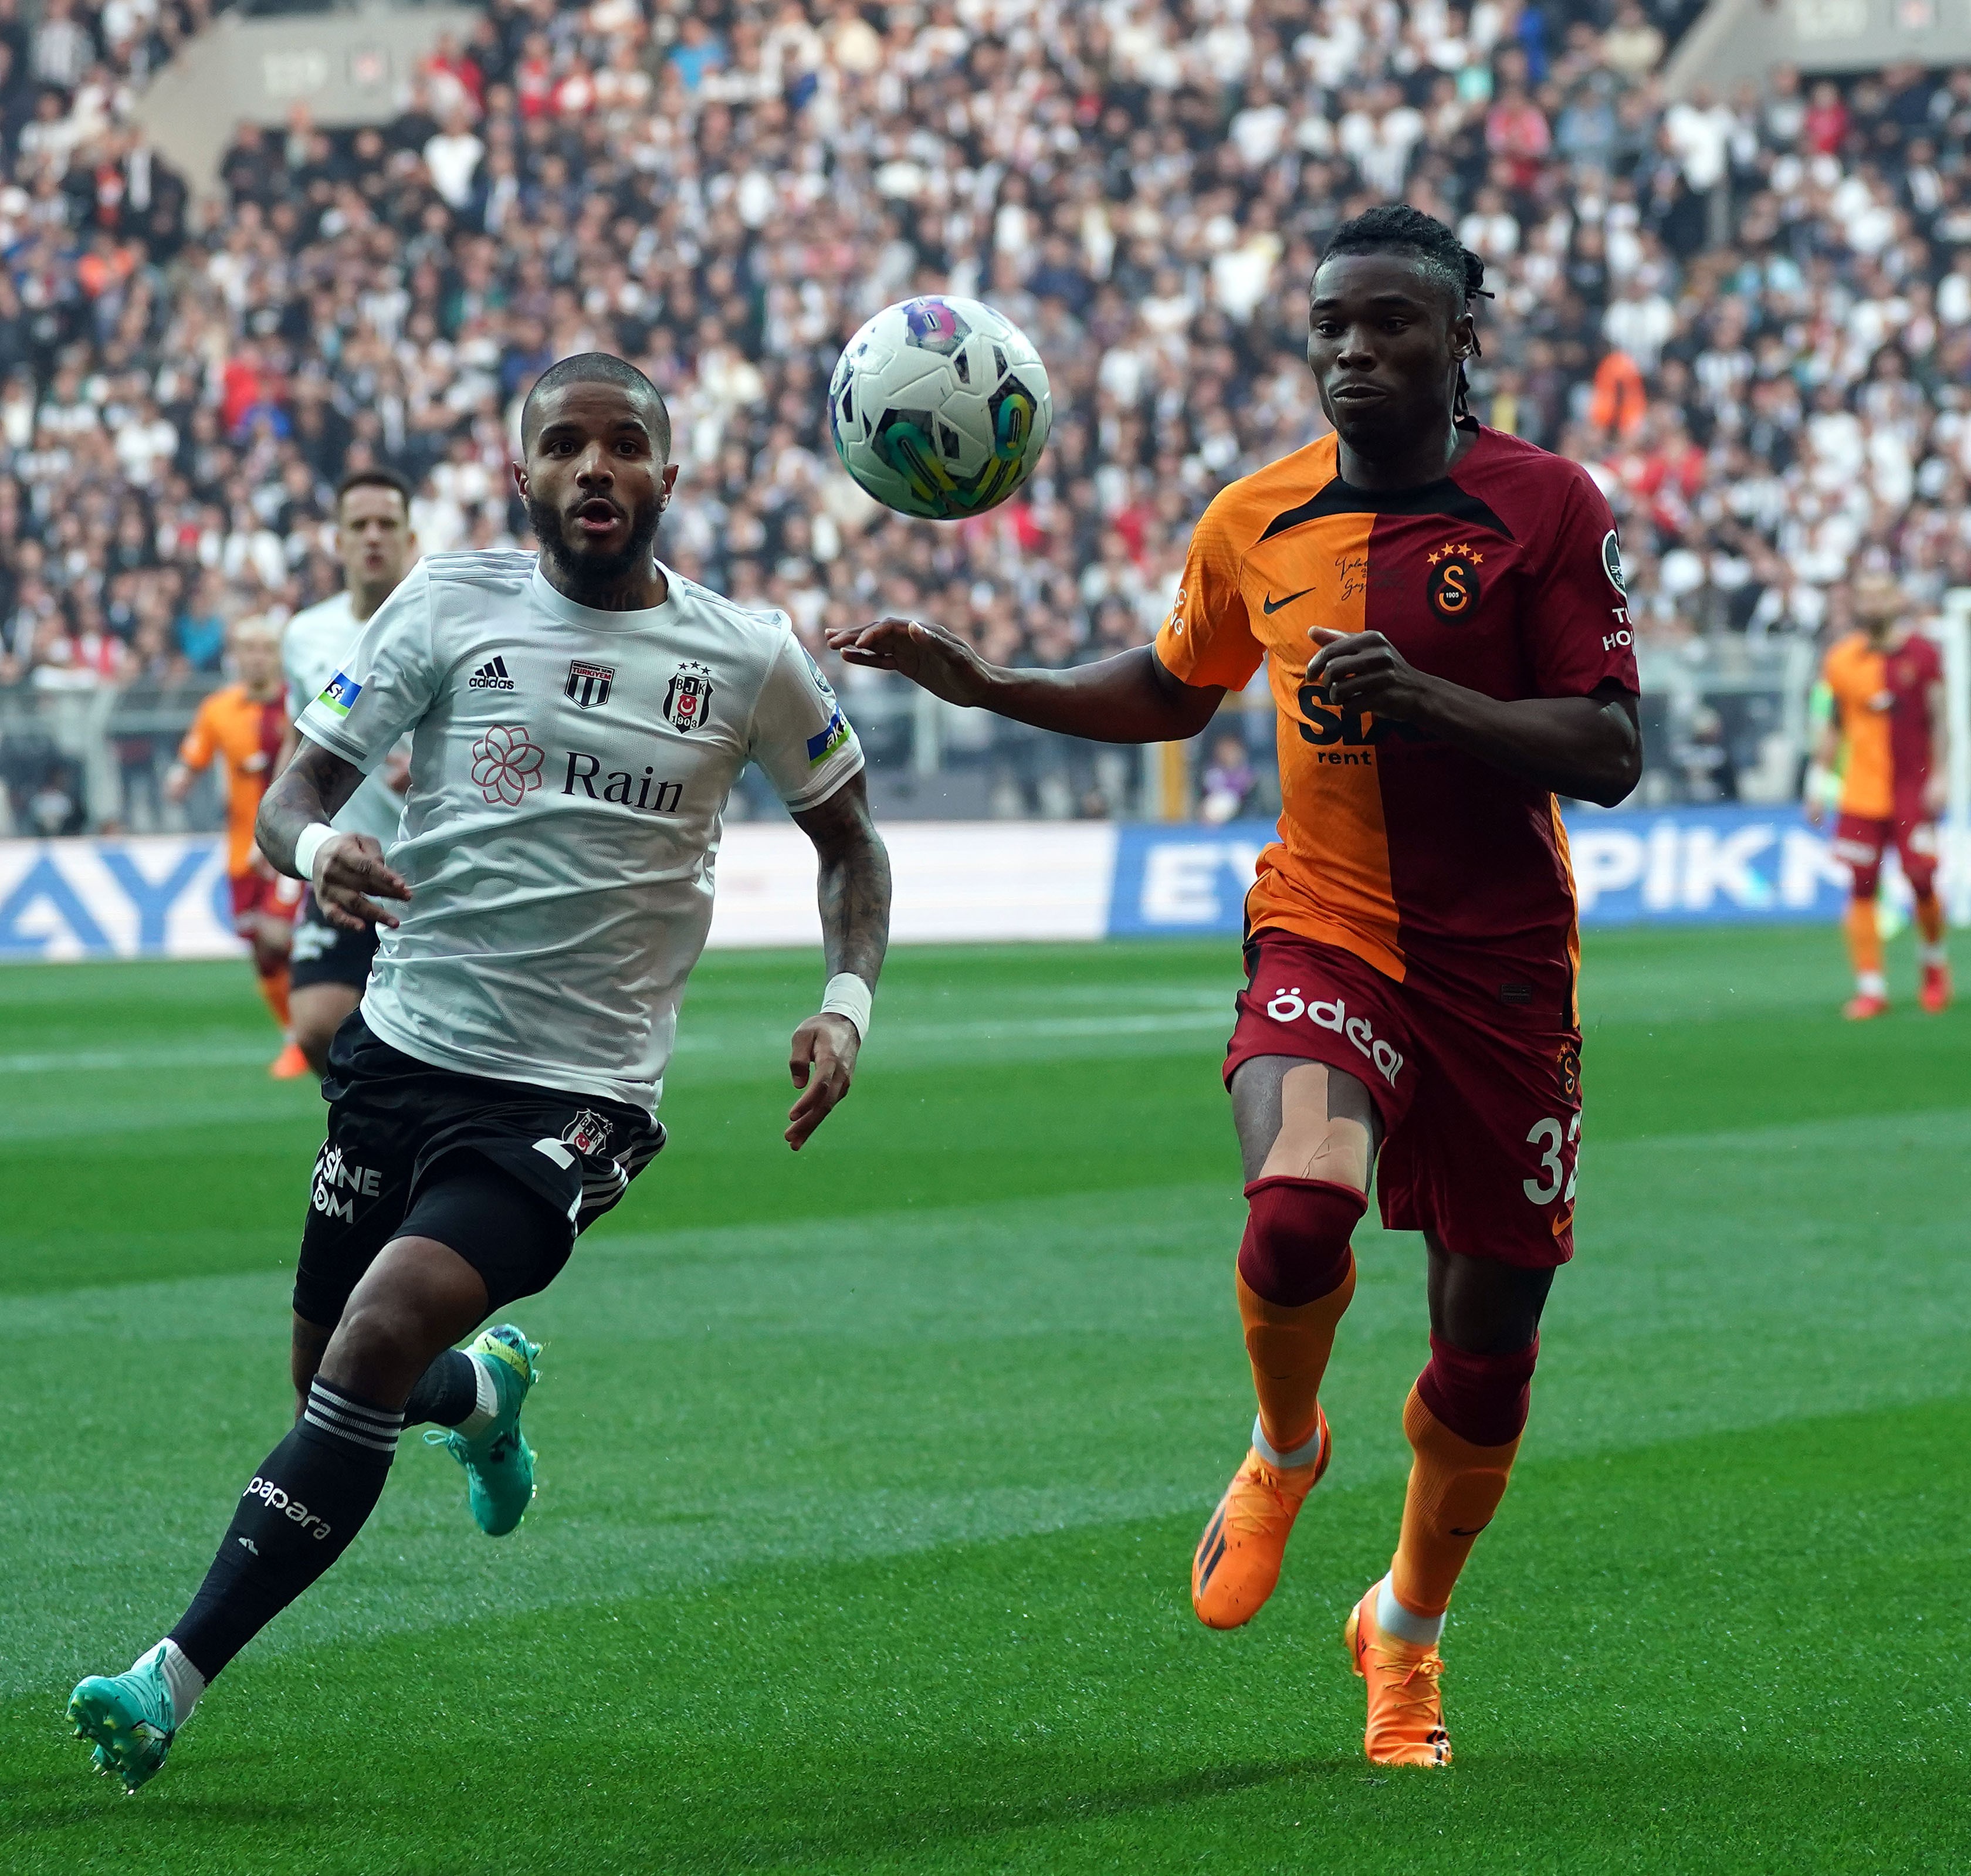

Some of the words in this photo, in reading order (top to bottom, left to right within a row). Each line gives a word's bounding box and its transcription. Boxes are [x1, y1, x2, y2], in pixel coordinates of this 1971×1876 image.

[469, 675, 514, 690] adidas
[675, 678, 706, 696] BJK
[670, 716, 698, 728] 1903
[1318, 751, 1372, 765] rent
[561, 751, 683, 813] Rain
[580, 1118, 602, 1146] BJK
[242, 1477, 331, 1540] papara
